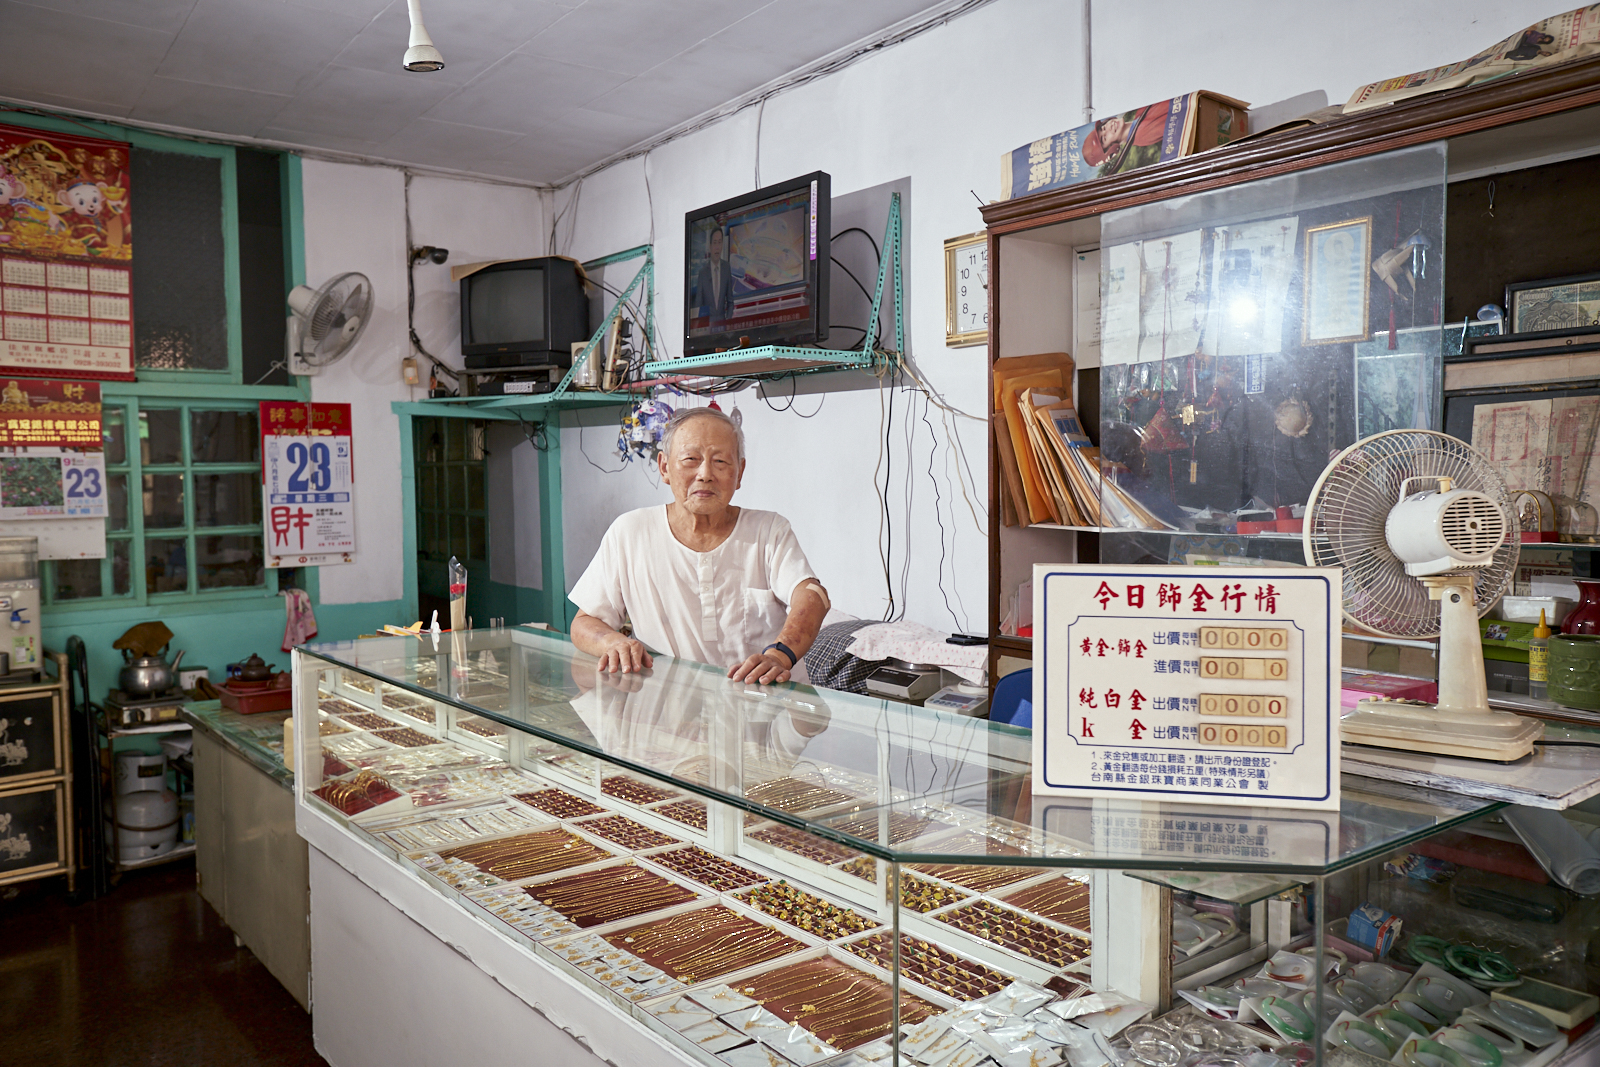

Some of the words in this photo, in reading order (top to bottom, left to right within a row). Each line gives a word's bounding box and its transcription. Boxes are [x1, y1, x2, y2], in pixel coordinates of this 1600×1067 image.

[969, 254, 976, 265] 11
[961, 268, 970, 280] 10
[961, 286, 967, 296] 9
[962, 303, 968, 314] 8
[972, 314, 976, 324] 7
[63, 384, 86, 400] 財
[63, 458, 71, 466] 9
[286, 442, 331, 492] 23
[66, 468, 102, 498] 23
[271, 506, 314, 550] 財
[1094, 581, 1281, 614] 今日飾金行情
[1153, 631, 1180, 644] 出價
[1154, 660, 1182, 674] 進價
[1079, 688, 1147, 710] 純白金
[1153, 697, 1180, 710] 出價
[1153, 726, 1180, 740] 出價
[1258, 780, 1269, 790] 製
